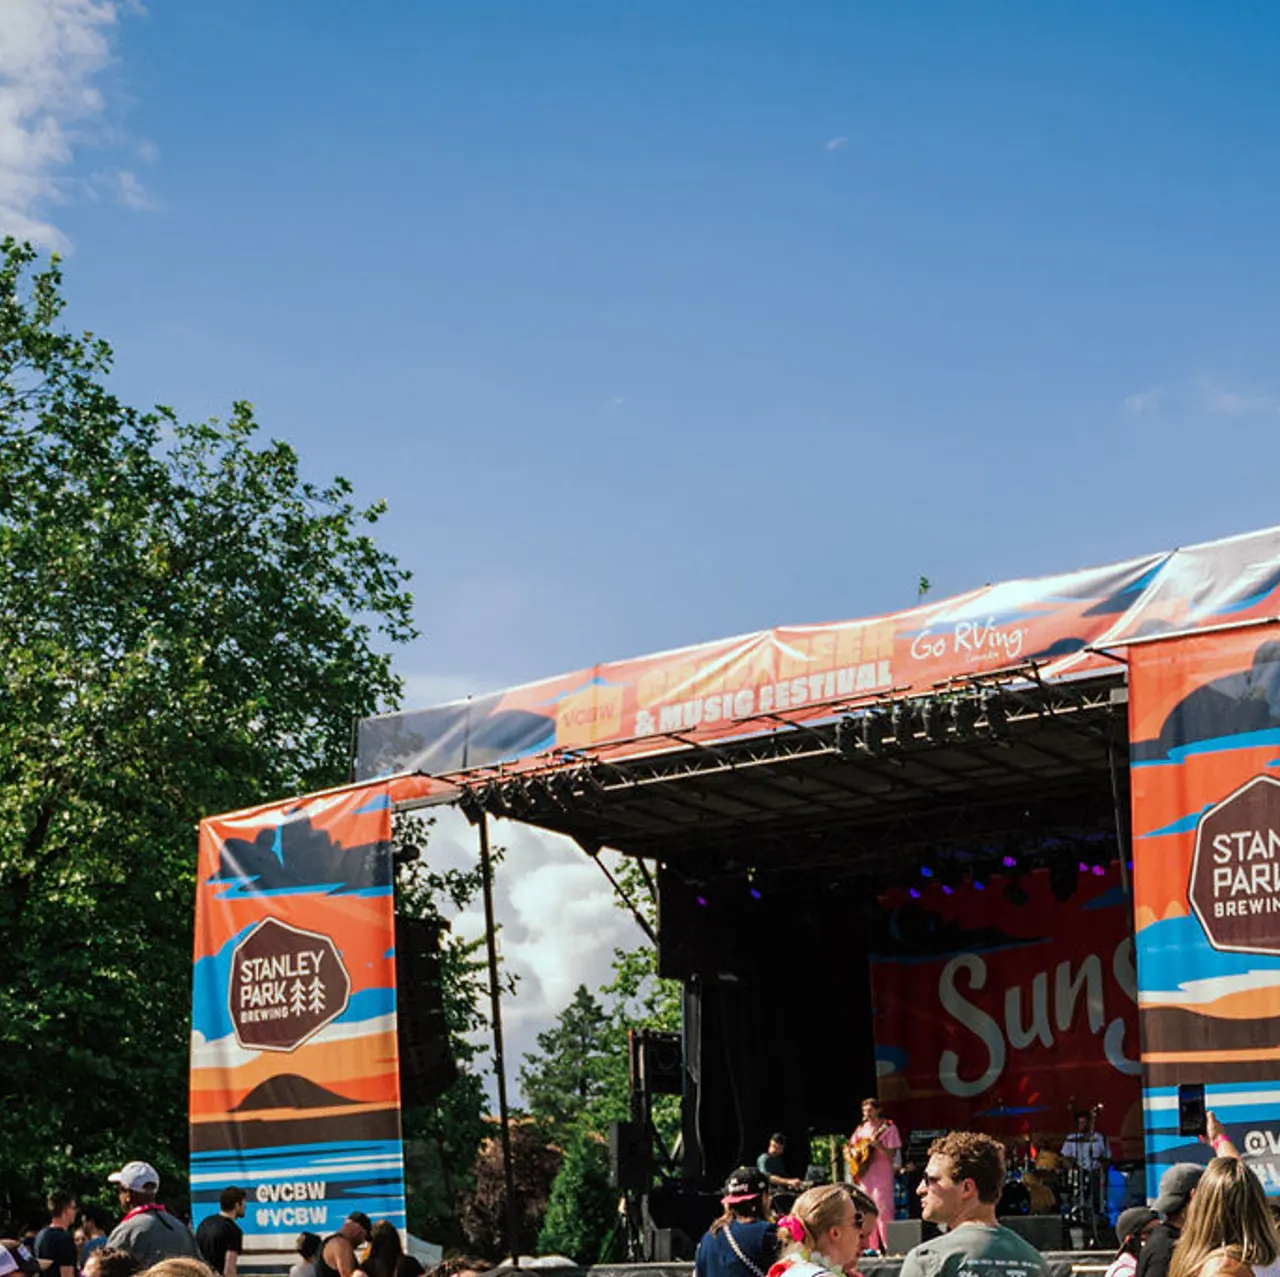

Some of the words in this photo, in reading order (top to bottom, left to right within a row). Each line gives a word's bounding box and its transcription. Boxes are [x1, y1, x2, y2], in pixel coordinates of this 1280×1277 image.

[910, 629, 946, 660] Go
[954, 616, 1023, 659] RVing
[634, 709, 655, 737] &
[659, 689, 754, 731] MUSIC
[759, 660, 893, 711] FESTIVAL
[240, 949, 325, 983] STANLEY
[240, 981, 287, 1008] PARK
[240, 1006, 289, 1024] BREWING
[256, 1182, 326, 1203] @VCBW
[256, 1206, 327, 1227] #VCBW
